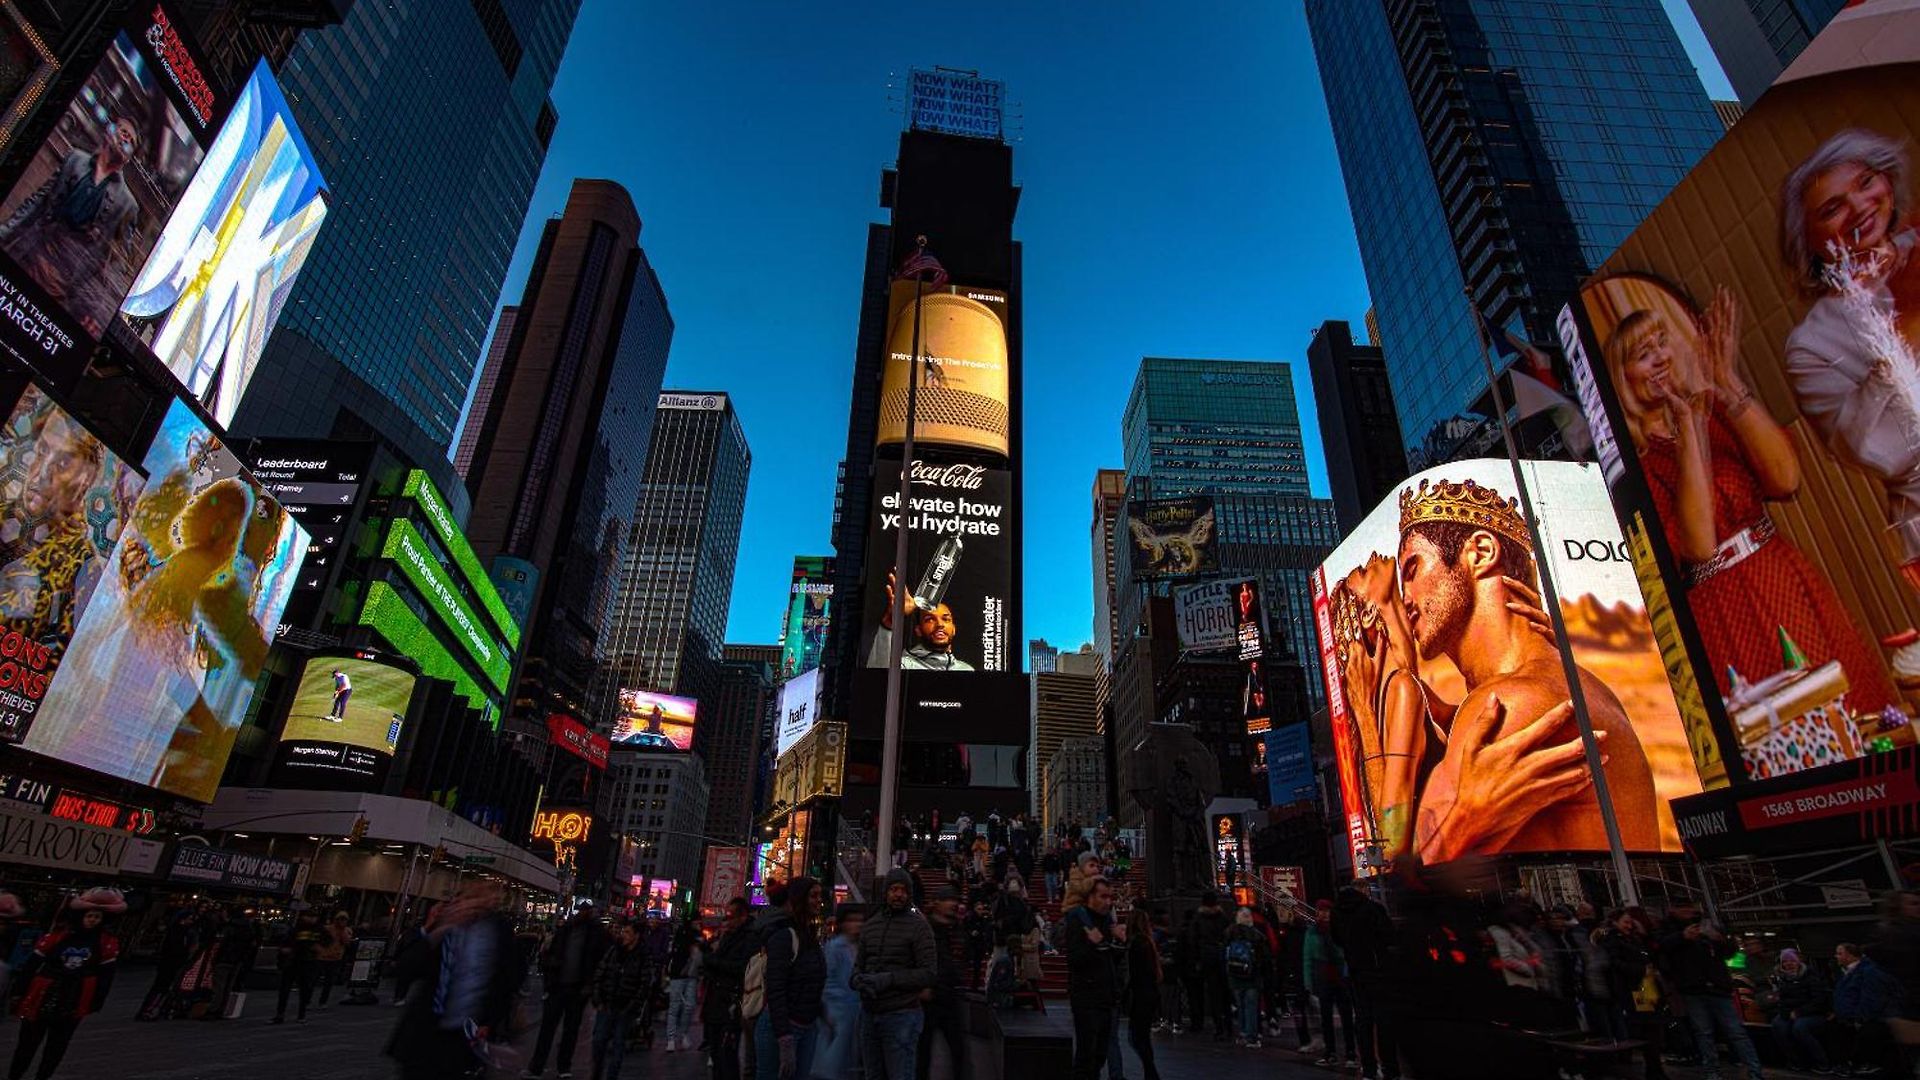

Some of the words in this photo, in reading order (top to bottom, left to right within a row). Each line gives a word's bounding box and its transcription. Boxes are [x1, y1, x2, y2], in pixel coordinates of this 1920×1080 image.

[914, 73, 945, 87] NOW
[951, 78, 999, 95] WHAT?
[914, 84, 945, 98] NOW
[950, 89, 999, 107] WHAT?
[912, 97, 945, 112] NOW
[949, 101, 998, 120] WHAT?
[912, 110, 944, 124] NOW
[948, 115, 998, 132] WHAT?
[968, 292, 1005, 303] SAMSUNG
[16, 293, 30, 308] IN
[29, 304, 75, 349] THEATRES
[42, 336, 60, 355] 31
[891, 352, 943, 366] Introuing
[945, 357, 961, 366] The
[1217, 373, 1281, 385] BARCLAYS
[659, 396, 700, 407] Allianz
[257, 457, 328, 470] Leaderboard
[269, 471, 296, 479] Round
[337, 473, 357, 481] Total
[420, 479, 439, 518] Morgan
[881, 491, 955, 514] elvate
[959, 496, 1001, 518] how
[922, 512, 1001, 536] hydrate
[1184, 583, 1223, 606] LITTLE
[982, 596, 995, 671] smartwater
[1185, 604, 1236, 642] HORRO
[0, 626, 51, 670] ONS
[788, 702, 807, 725] half
[293, 746, 315, 756] Morgan
[315, 748, 340, 758] Stanley
[15, 778, 51, 804] FIN
[1761, 800, 1795, 818] 1568
[1795, 783, 1887, 813] BROADWAY
[177, 848, 207, 868] BLUE
[207, 854, 226, 870] FIN
[229, 853, 259, 877] NOW
[260, 858, 290, 880] OPEN
